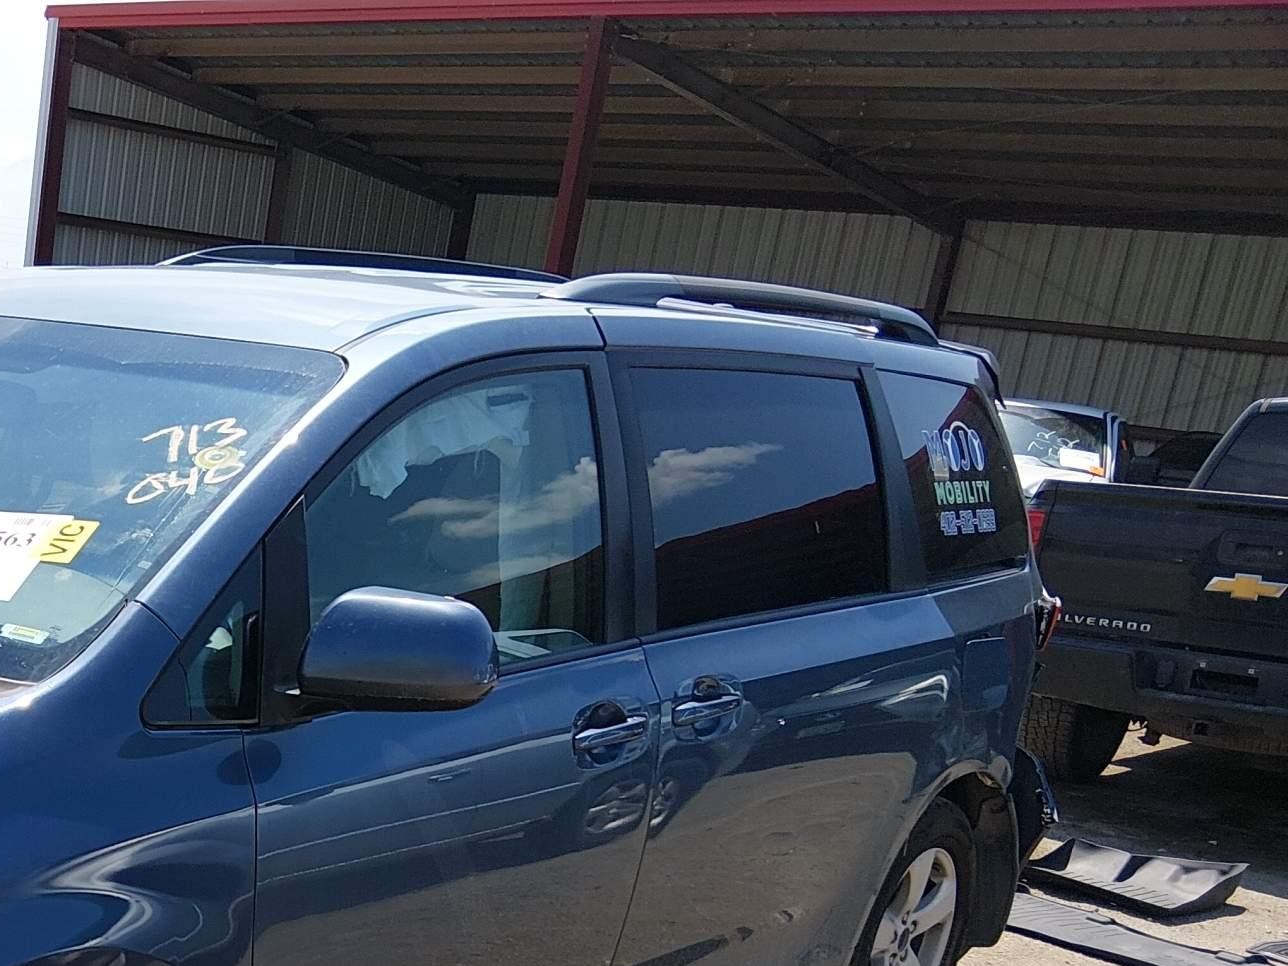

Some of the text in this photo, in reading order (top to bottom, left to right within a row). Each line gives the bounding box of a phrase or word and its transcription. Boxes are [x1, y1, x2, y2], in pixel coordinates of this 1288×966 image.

[141, 417, 247, 463] 713
[921, 428, 985, 472] MOJO
[933, 480, 991, 505] MOBILITY
[40, 522, 85, 558] VIC
[1057, 613, 1152, 632] ILVERADO
